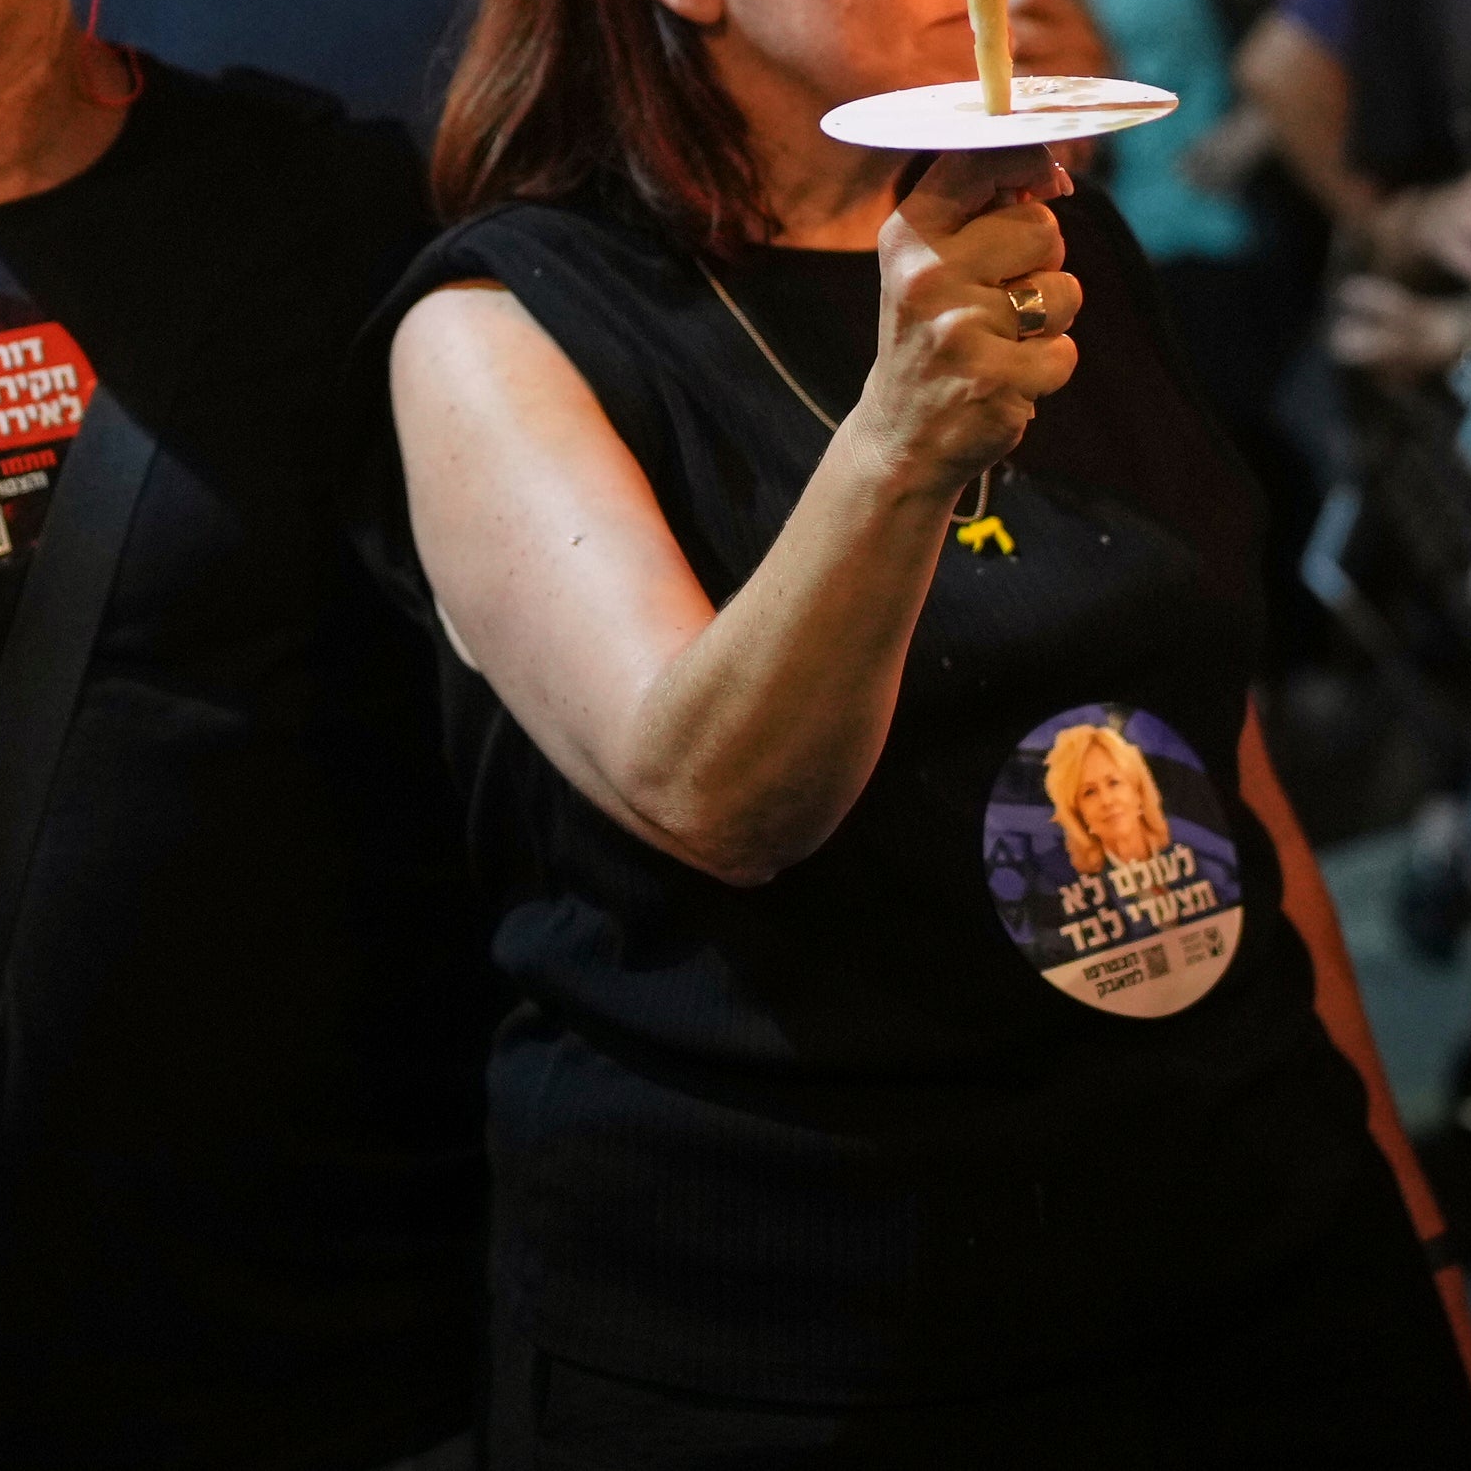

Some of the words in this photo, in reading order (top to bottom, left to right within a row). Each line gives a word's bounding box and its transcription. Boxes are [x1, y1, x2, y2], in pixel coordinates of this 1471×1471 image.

[1058, 873, 1107, 917] לא
[1107, 843, 1197, 899] לעולם
[1125, 879, 1219, 928] תצעדי
[1059, 906, 1127, 953] לבד
